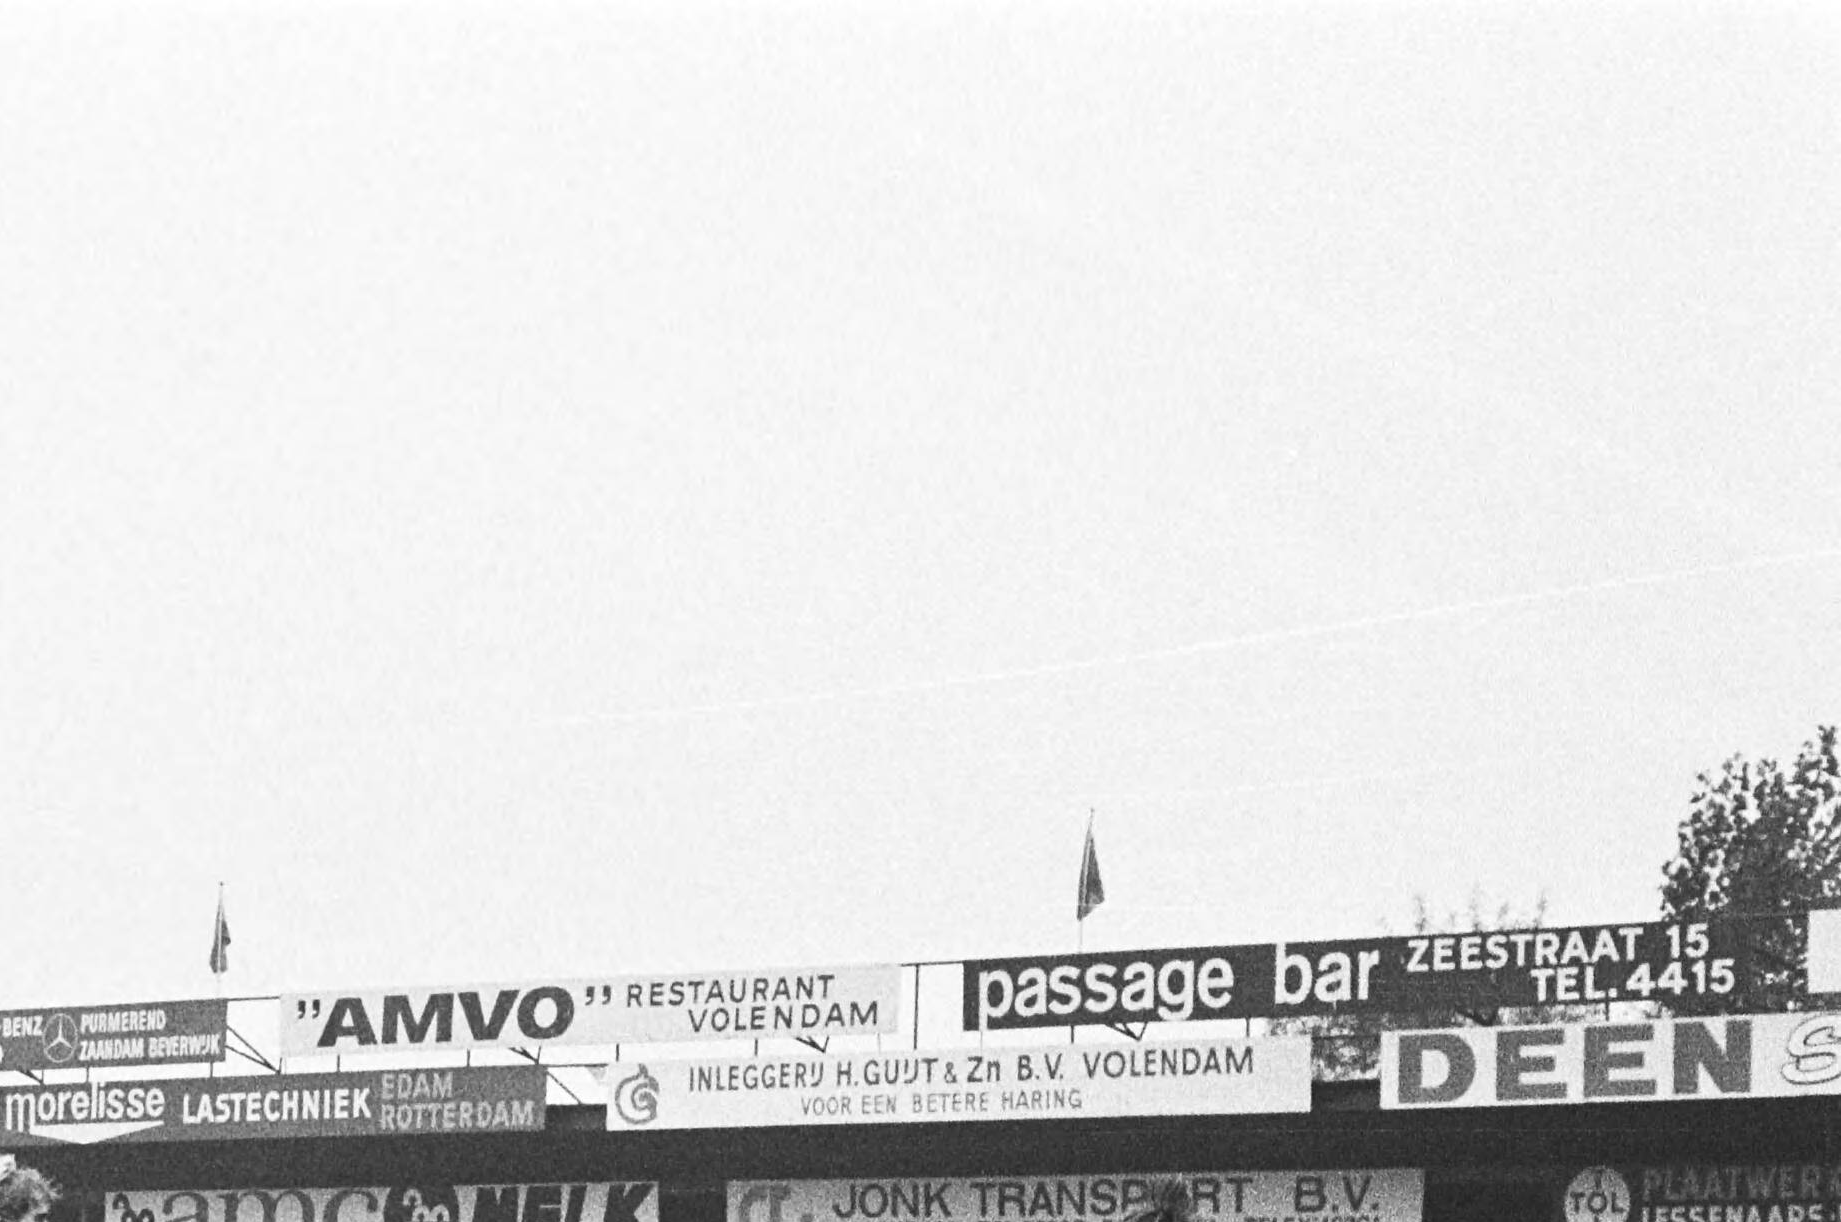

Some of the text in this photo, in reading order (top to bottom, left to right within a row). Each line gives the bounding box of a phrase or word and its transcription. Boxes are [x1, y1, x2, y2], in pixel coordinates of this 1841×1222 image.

[1407, 924, 1709, 972] ZEESTRAAT 15
[627, 976, 834, 1008] RESTAURANT
[980, 942, 1380, 1030] passage bar
[1531, 959, 1736, 1001] TEL. 4415
[80, 1010, 167, 1033] PURMEREND
[688, 1002, 879, 1033] VOLENDAM
[79, 1037, 144, 1060] ZAANDAM
[1016, 1051, 1066, 1081] B.V.
[1083, 1045, 1255, 1077] VOLENDAM
[1398, 1020, 1752, 1102] DEEN
[380, 1072, 453, 1100] EDAM
[800, 1088, 1084, 1117] VOOR EEN BETERE HARING
[6, 1083, 165, 1132] morelisse
[182, 1087, 372, 1125] LASTECHNIEK
[380, 1101, 535, 1129] ROTTERDAM
[832, 1174, 1379, 1218] JONK TRANSPRT B.V.
